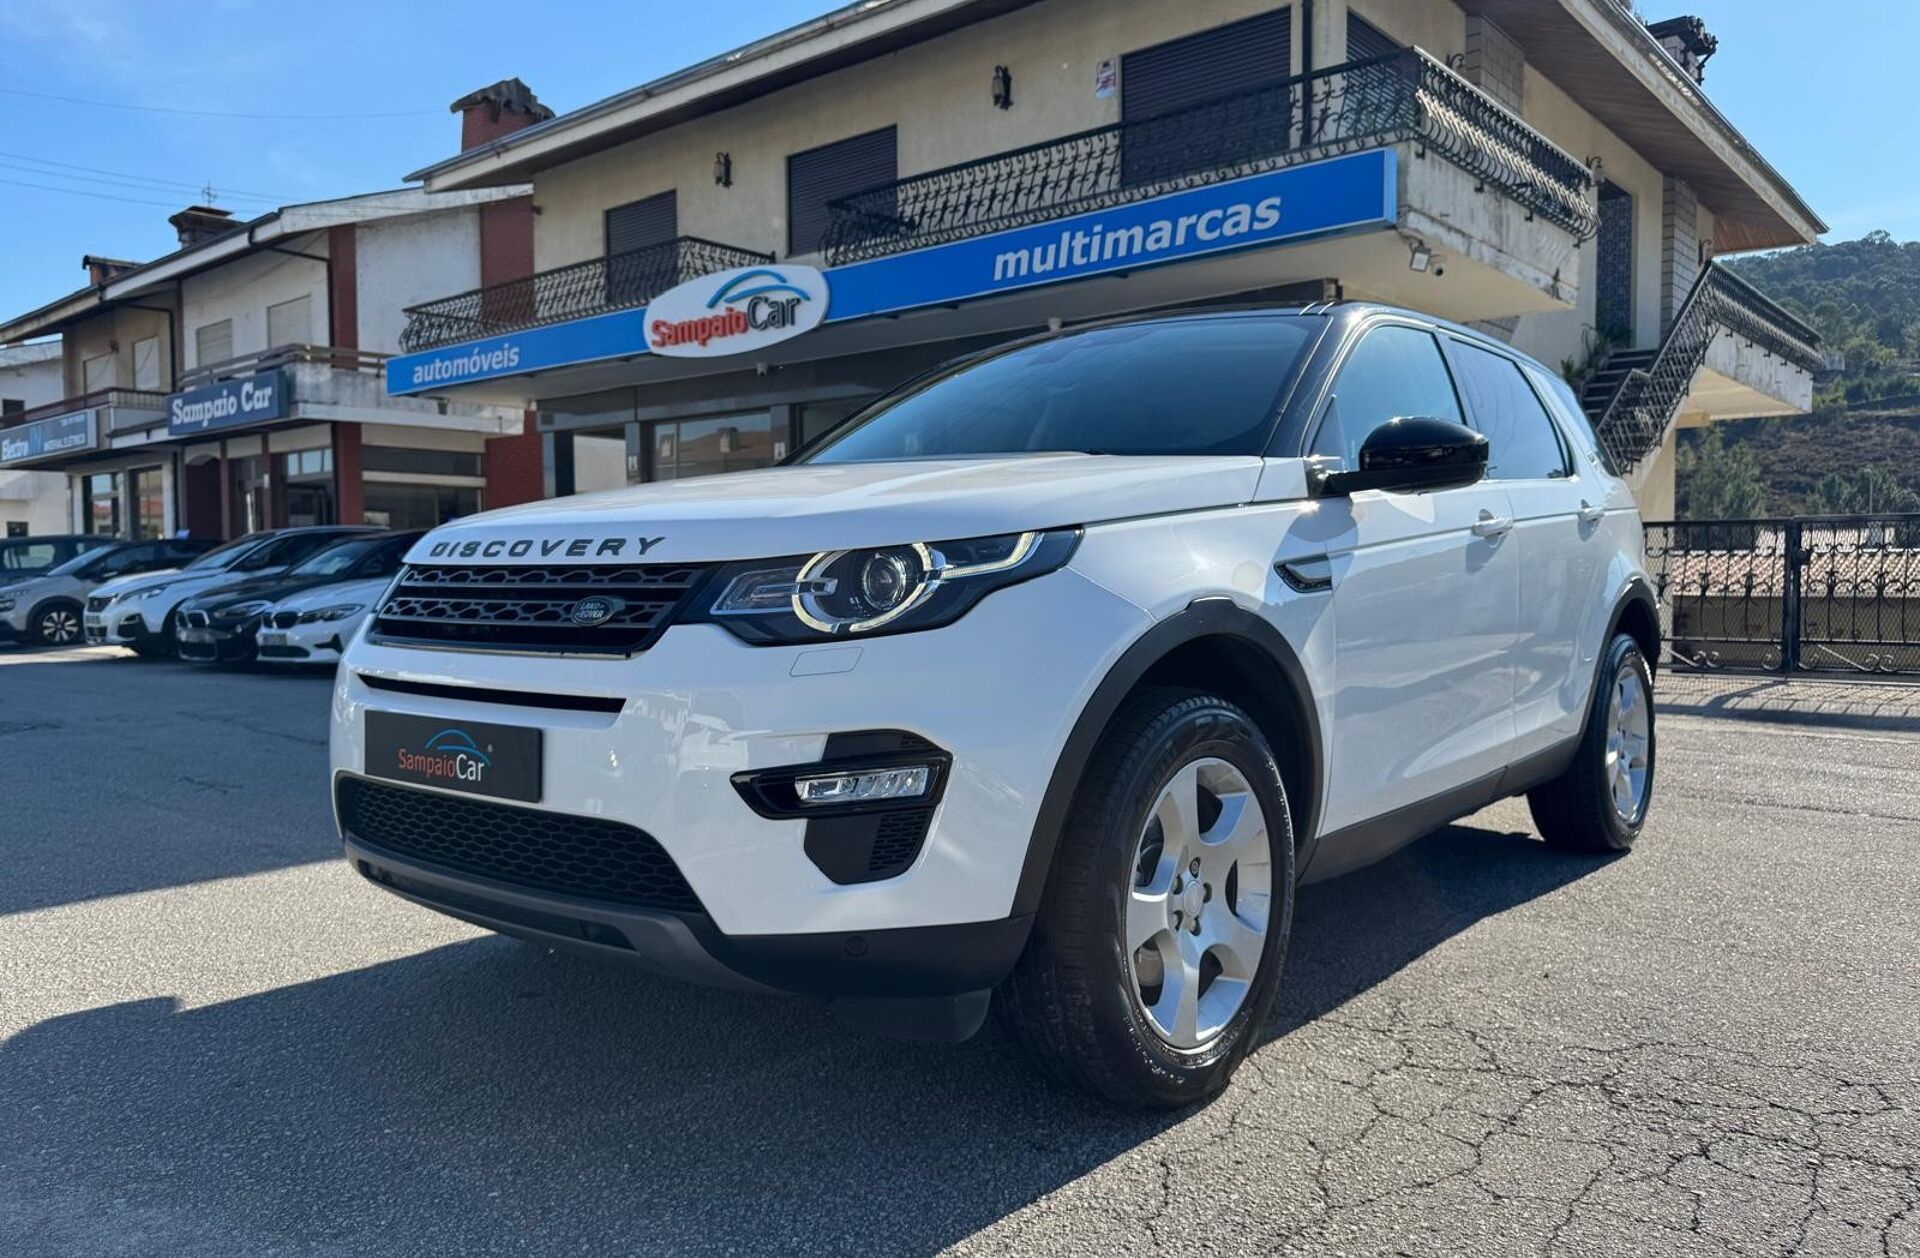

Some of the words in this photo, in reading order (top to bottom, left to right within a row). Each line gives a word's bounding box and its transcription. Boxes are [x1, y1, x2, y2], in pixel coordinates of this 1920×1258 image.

[993, 196, 1281, 281] multimarcas
[651, 296, 801, 347] SampaioCar
[413, 343, 519, 384] automóveis
[172, 388, 237, 427] Sampaio
[241, 382, 272, 412] Car
[429, 537, 666, 558] DISCOVERY
[398, 748, 484, 781] SampaioCar
